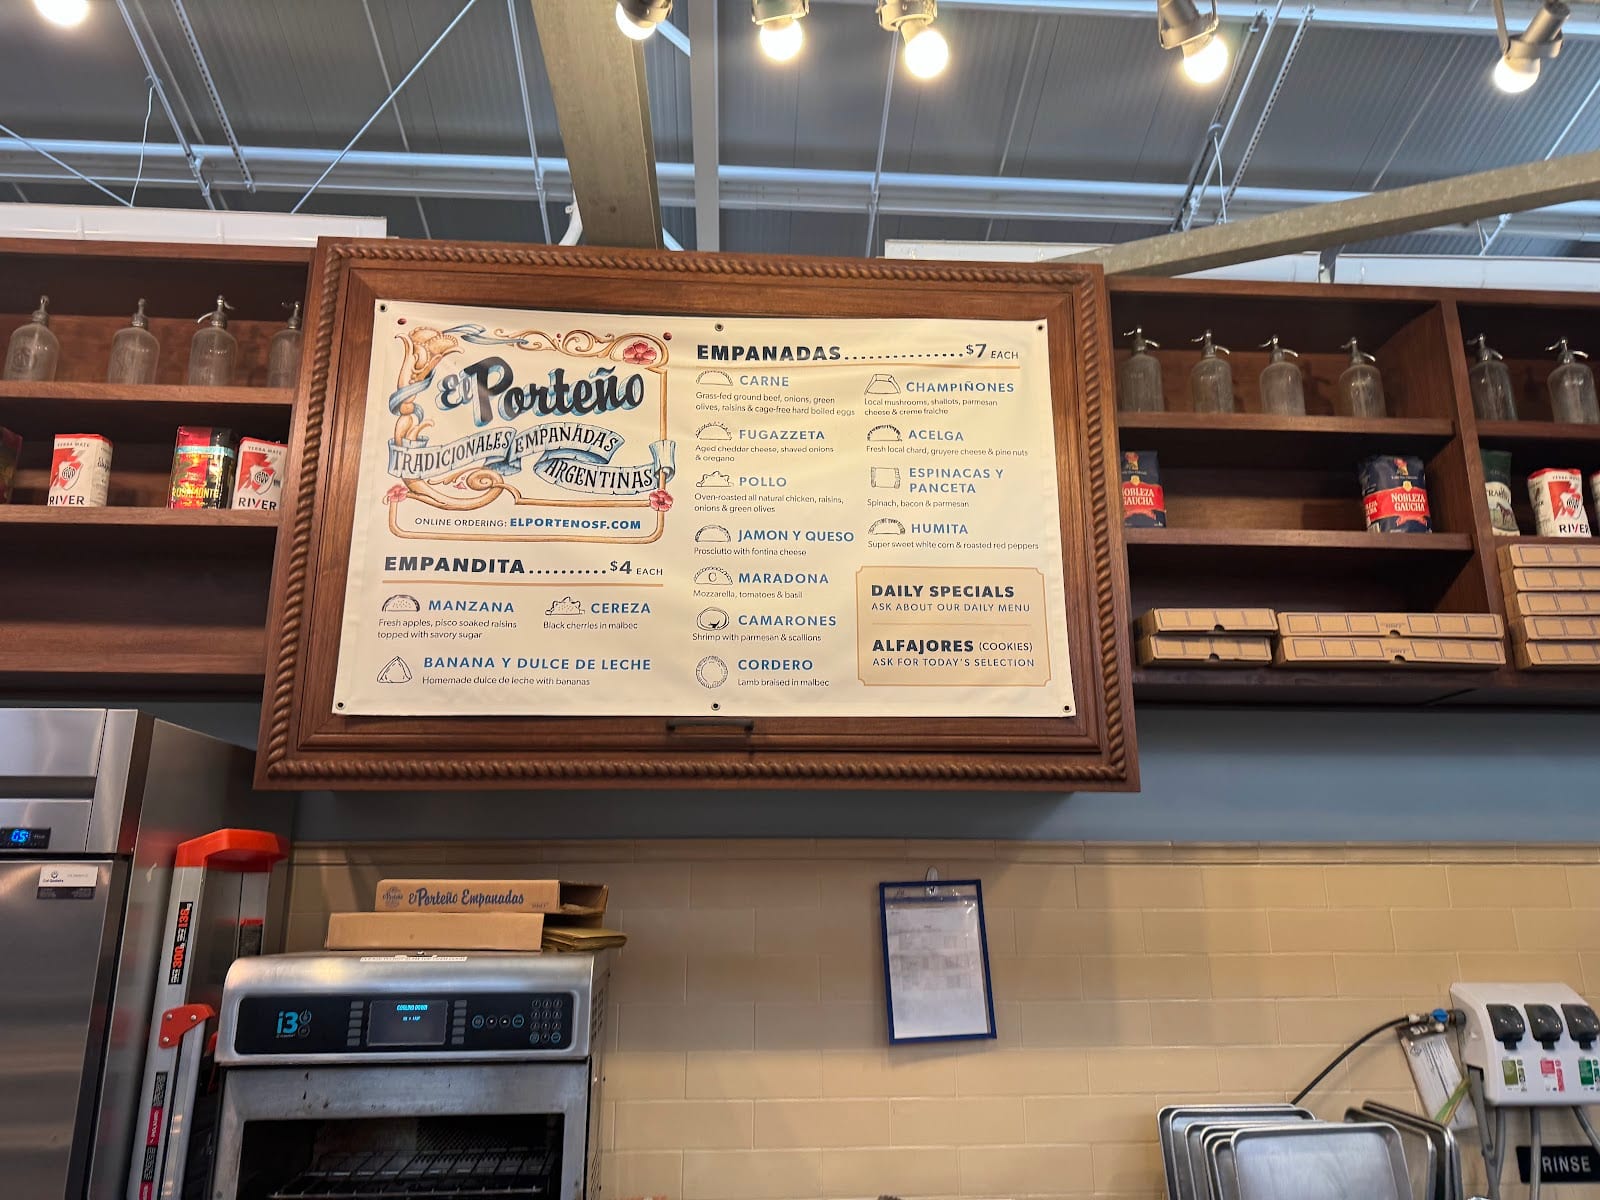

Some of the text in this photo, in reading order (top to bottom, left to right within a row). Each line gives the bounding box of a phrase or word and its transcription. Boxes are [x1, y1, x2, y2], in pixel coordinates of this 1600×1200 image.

[697, 343, 1019, 361] EMPANADAS $7 EACH
[740, 376, 789, 386] CARNE
[464, 356, 645, 426] Porteño
[906, 381, 1013, 392] CHAMPIÑONES
[734, 394, 762, 402] ground
[764, 394, 782, 403] beef,
[784, 395, 812, 403] onions,
[812, 398, 836, 407] green
[962, 399, 998, 407] parmesan
[696, 403, 720, 412] olives,
[754, 406, 790, 414] cage-free
[792, 406, 810, 414] hard
[836, 409, 856, 417] eggs
[864, 408, 890, 416] cheese
[892, 408, 898, 416] &
[740, 430, 824, 439] FUGAZZETA
[909, 430, 963, 441] ACELGA
[392, 426, 619, 473] TRADICIONALES EMPANADAS
[696, 445, 716, 453] Aged
[718, 445, 750, 453] cheddar
[780, 445, 808, 453] shaved
[808, 445, 834, 453] onions
[866, 445, 886, 453] Fresh
[888, 445, 904, 453] local
[906, 446, 930, 455] chard,
[960, 448, 986, 456] cheese
[996, 449, 1012, 457] pine
[1012, 449, 1028, 457] nuts
[702, 455, 734, 463] oregano
[544, 458, 653, 489] ARGENTINAS
[910, 468, 1003, 478] ESPINACAS Y
[740, 477, 786, 487] POLLO
[910, 483, 976, 493] PANCETA
[50, 495, 85, 505] RIVER
[694, 493, 746, 501] Oven-roasted
[748, 494, 756, 502] all
[758, 494, 784, 502] natural
[1391, 493, 1426, 502] NOBLEZA
[238, 497, 277, 510] RIVER
[866, 499, 898, 508] Spinach,
[924, 499, 932, 507] &
[1394, 502, 1425, 512] GAUCHA
[694, 504, 720, 512] onions
[722, 504, 728, 512] &
[730, 507, 752, 515] green
[415, 518, 451, 526] ONLINE
[510, 518, 640, 529] ELPORTENOSF.COM
[912, 524, 968, 534] HUMITA
[1559, 524, 1590, 534] RIVER
[738, 530, 854, 542] JAMON Y QUESO
[868, 541, 890, 549] Super
[892, 540, 914, 548] sweet
[956, 541, 962, 549] &
[964, 541, 992, 549] roasted
[1008, 543, 1038, 551] peppers
[780, 548, 806, 556] cheese
[384, 556, 663, 576] EMPANDITA $4 EACH
[739, 573, 828, 583] MARADONA
[692, 590, 738, 598] Mozzarella,
[740, 591, 776, 599] tomatoes
[872, 585, 1014, 598] DAILY SPECIALS
[429, 600, 514, 612] MANZANA
[591, 603, 650, 613] CEREZA
[872, 603, 891, 611] ASK
[896, 603, 932, 611] ABOUT
[999, 604, 1029, 612] MENU
[402, 619, 432, 628] apples,
[434, 619, 458, 627] pisco
[492, 620, 516, 628] raisins
[544, 621, 564, 629] Black
[566, 621, 598, 629] cherries
[739, 615, 836, 626] CAMARONES
[378, 631, 410, 640] topped
[430, 632, 458, 640] savory
[458, 632, 482, 641] sugar
[692, 633, 720, 642] Shrimp
[740, 635, 780, 643] parmesan
[872, 640, 1032, 653] ALFAJORES (COOKIES)
[424, 657, 650, 670] BANANA Y DULCE DE LECHE
[738, 660, 812, 670] CORDERO
[873, 658, 893, 666] ASK
[898, 658, 918, 666] FOR
[923, 658, 969, 666] TODAY'S
[422, 676, 472, 684] Homemade
[416, 888, 458, 906] Porteño
[461, 889, 524, 908] Empanadas
[1542, 1155, 1592, 1173] RINSE
